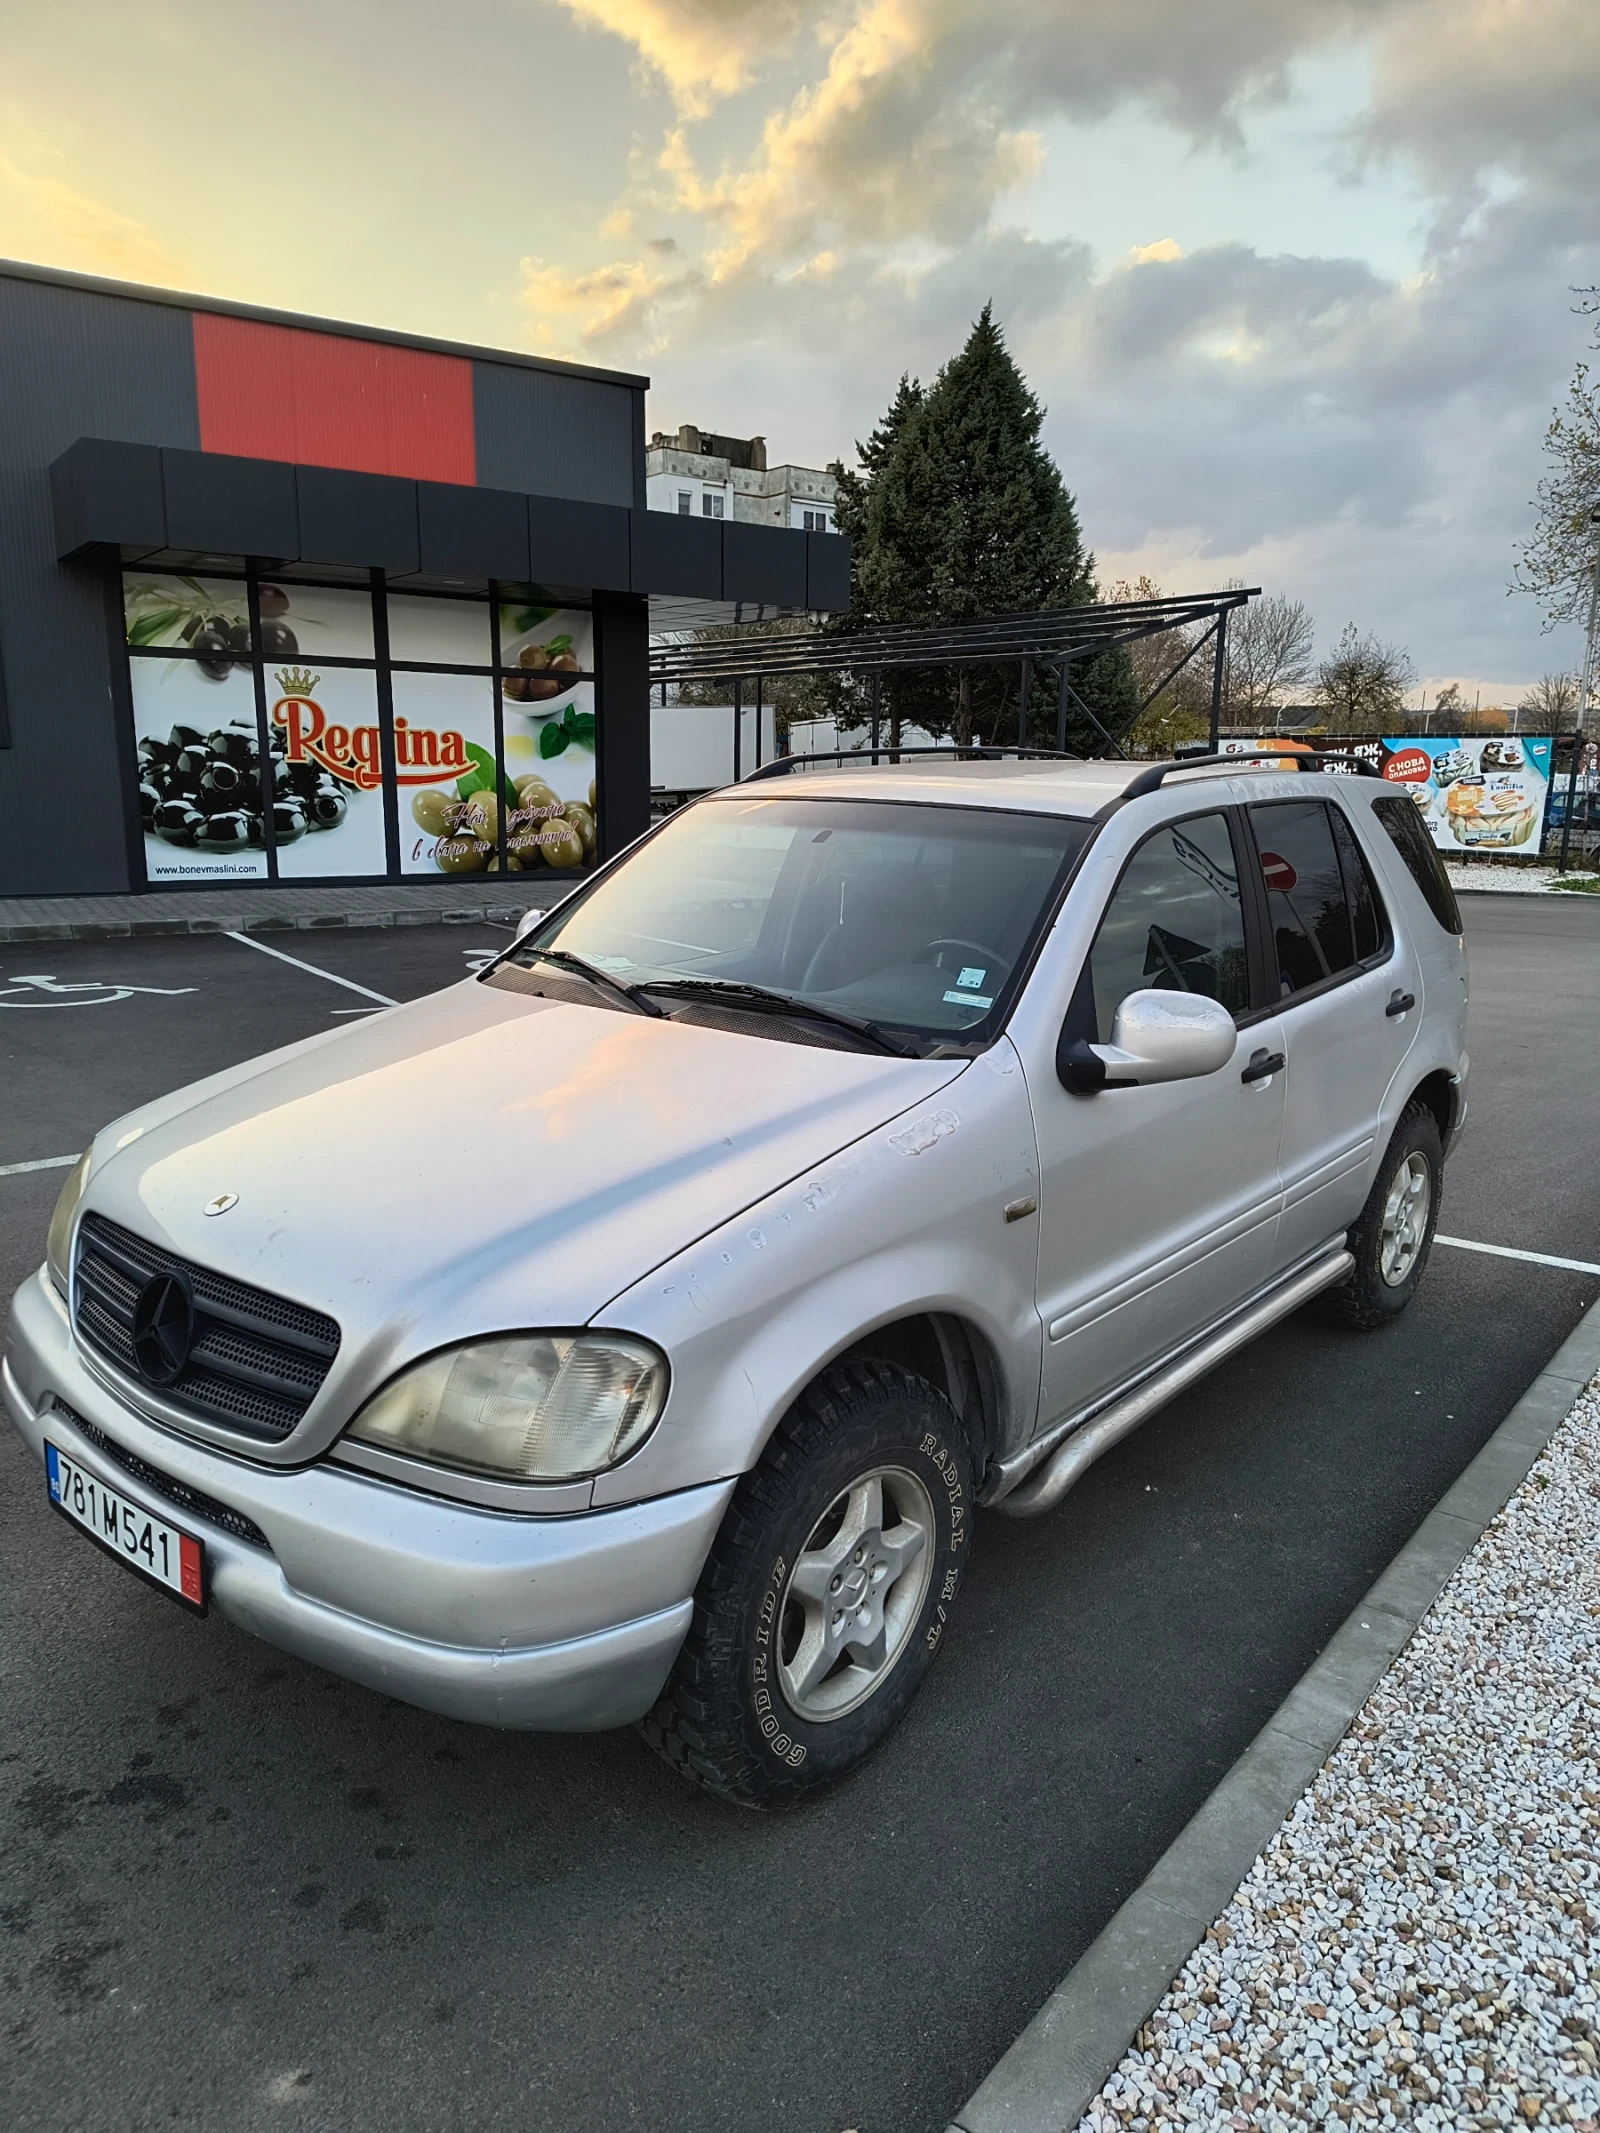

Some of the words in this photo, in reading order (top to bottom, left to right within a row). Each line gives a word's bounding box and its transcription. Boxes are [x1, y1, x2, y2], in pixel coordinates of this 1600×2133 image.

[273, 696, 479, 790] Regina
[1397, 757, 1426, 770] НОВА
[1388, 764, 1428, 779] ОПАКОВКА
[155, 864, 257, 875] www.bonevmaslini.com
[920, 1433, 965, 1551] RADIAL
[753, 1556, 807, 1767] GOODRIDE
